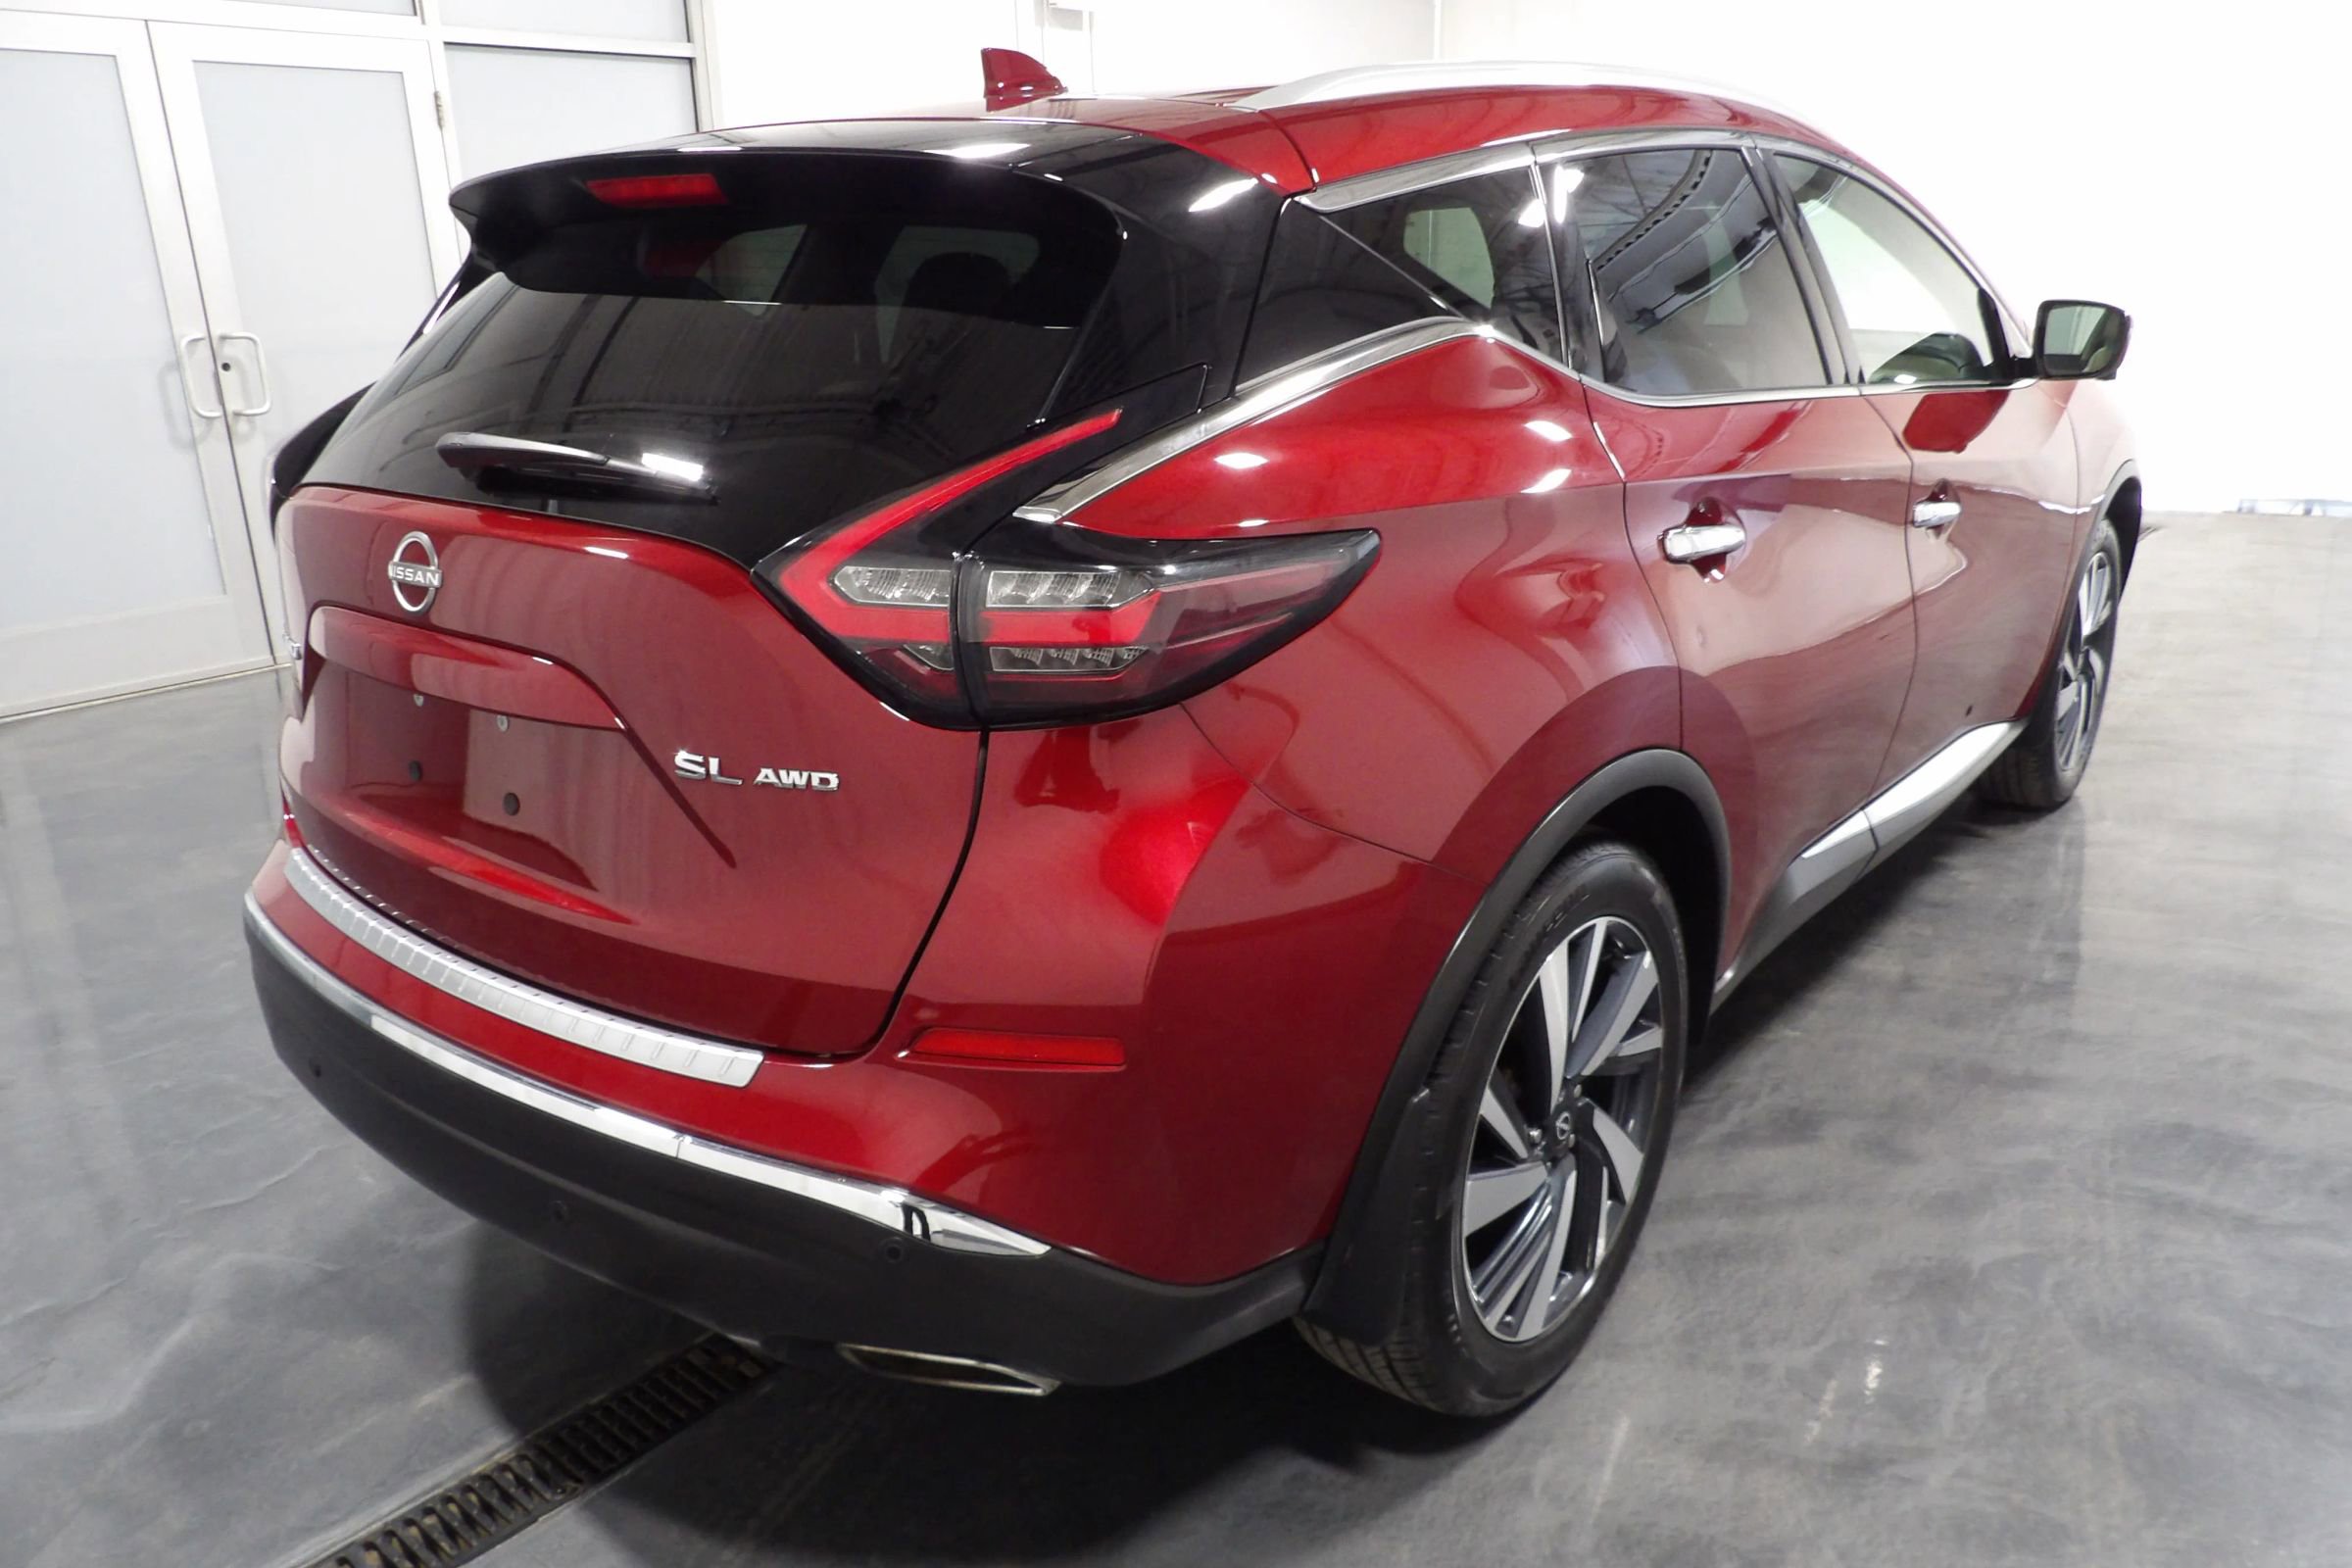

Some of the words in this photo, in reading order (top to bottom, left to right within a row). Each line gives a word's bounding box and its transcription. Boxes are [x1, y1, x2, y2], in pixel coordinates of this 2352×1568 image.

[389, 564, 440, 586] ISSAN
[674, 750, 743, 786] SL
[753, 767, 840, 791] AWD
